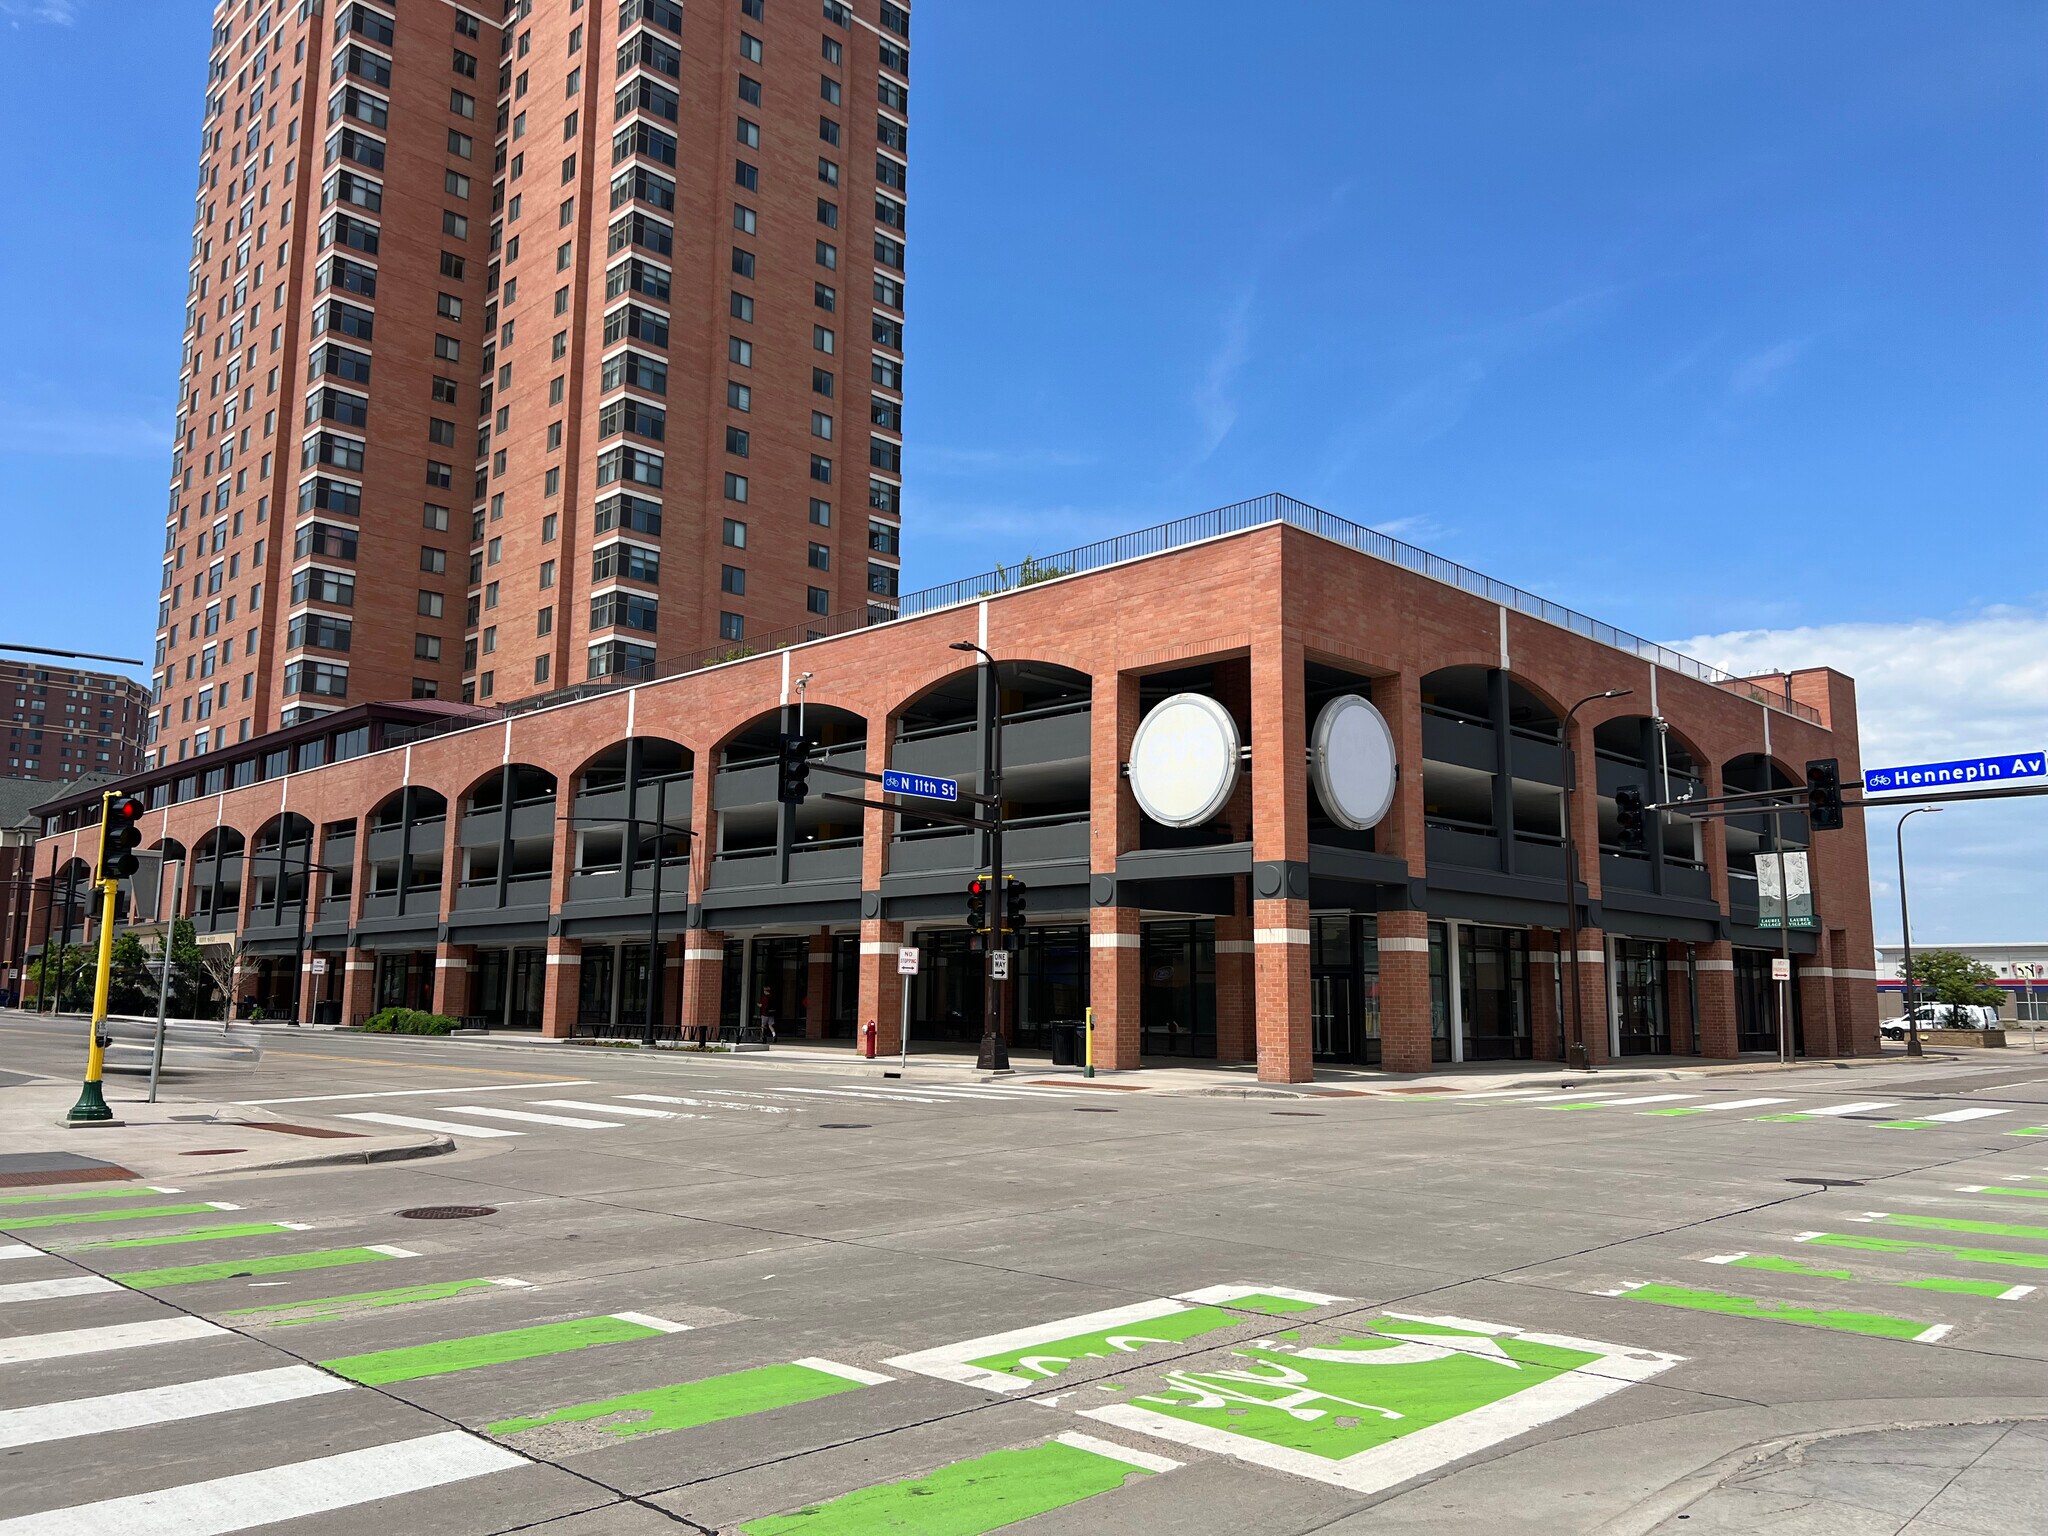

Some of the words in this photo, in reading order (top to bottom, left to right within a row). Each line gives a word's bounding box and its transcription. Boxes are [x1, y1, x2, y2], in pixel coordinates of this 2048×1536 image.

[1895, 763, 2000, 785] Hennepin
[2011, 758, 2041, 774] Av
[901, 776, 909, 790] N
[914, 779, 937, 794] 11th
[941, 783, 954, 797] St
[994, 953, 1006, 961] ONE
